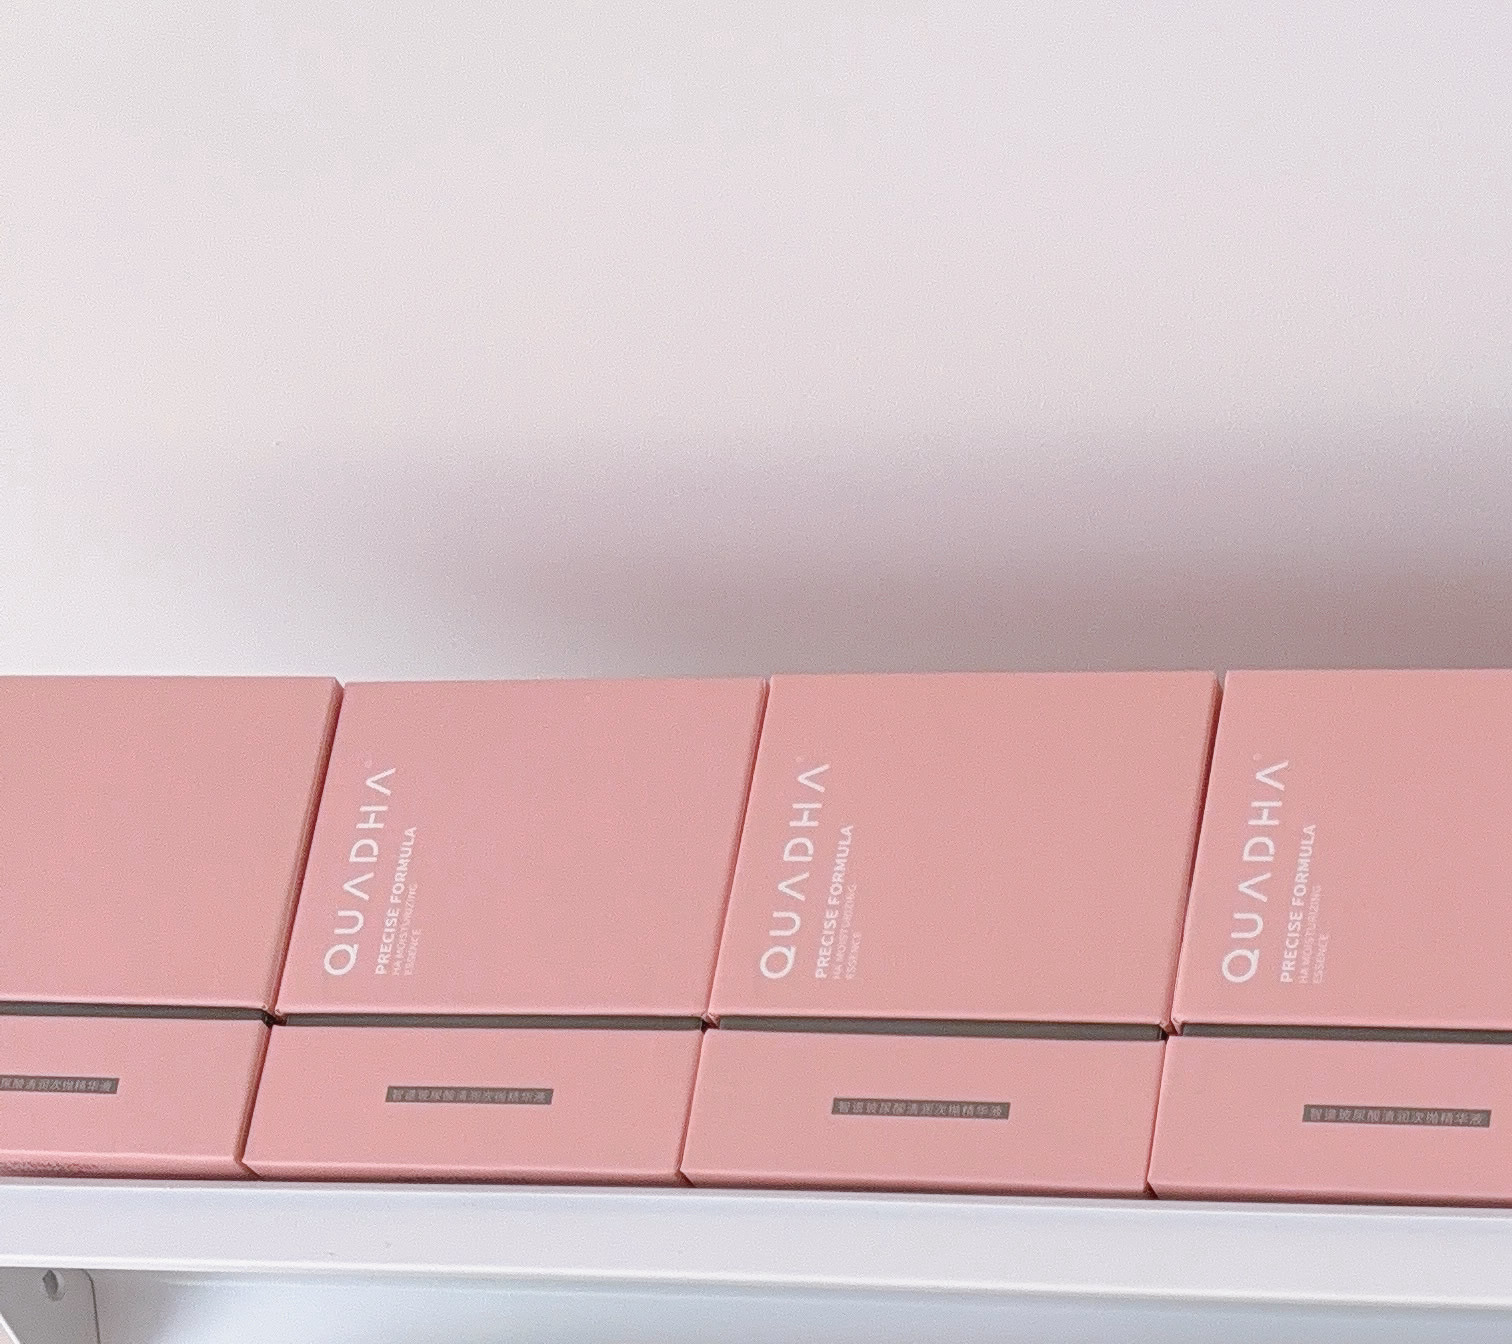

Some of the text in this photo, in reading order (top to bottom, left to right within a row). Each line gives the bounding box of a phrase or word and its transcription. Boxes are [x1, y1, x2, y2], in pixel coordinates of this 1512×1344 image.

[324, 768, 396, 976] QUADHA
[375, 827, 417, 975] PRECISE FORMULA
[760, 764, 830, 979] QUADHA
[815, 826, 853, 978] PRECISE FORMULA
[1222, 760, 1289, 983] QUADHA
[1280, 825, 1316, 982] PRECISE FORMULA
